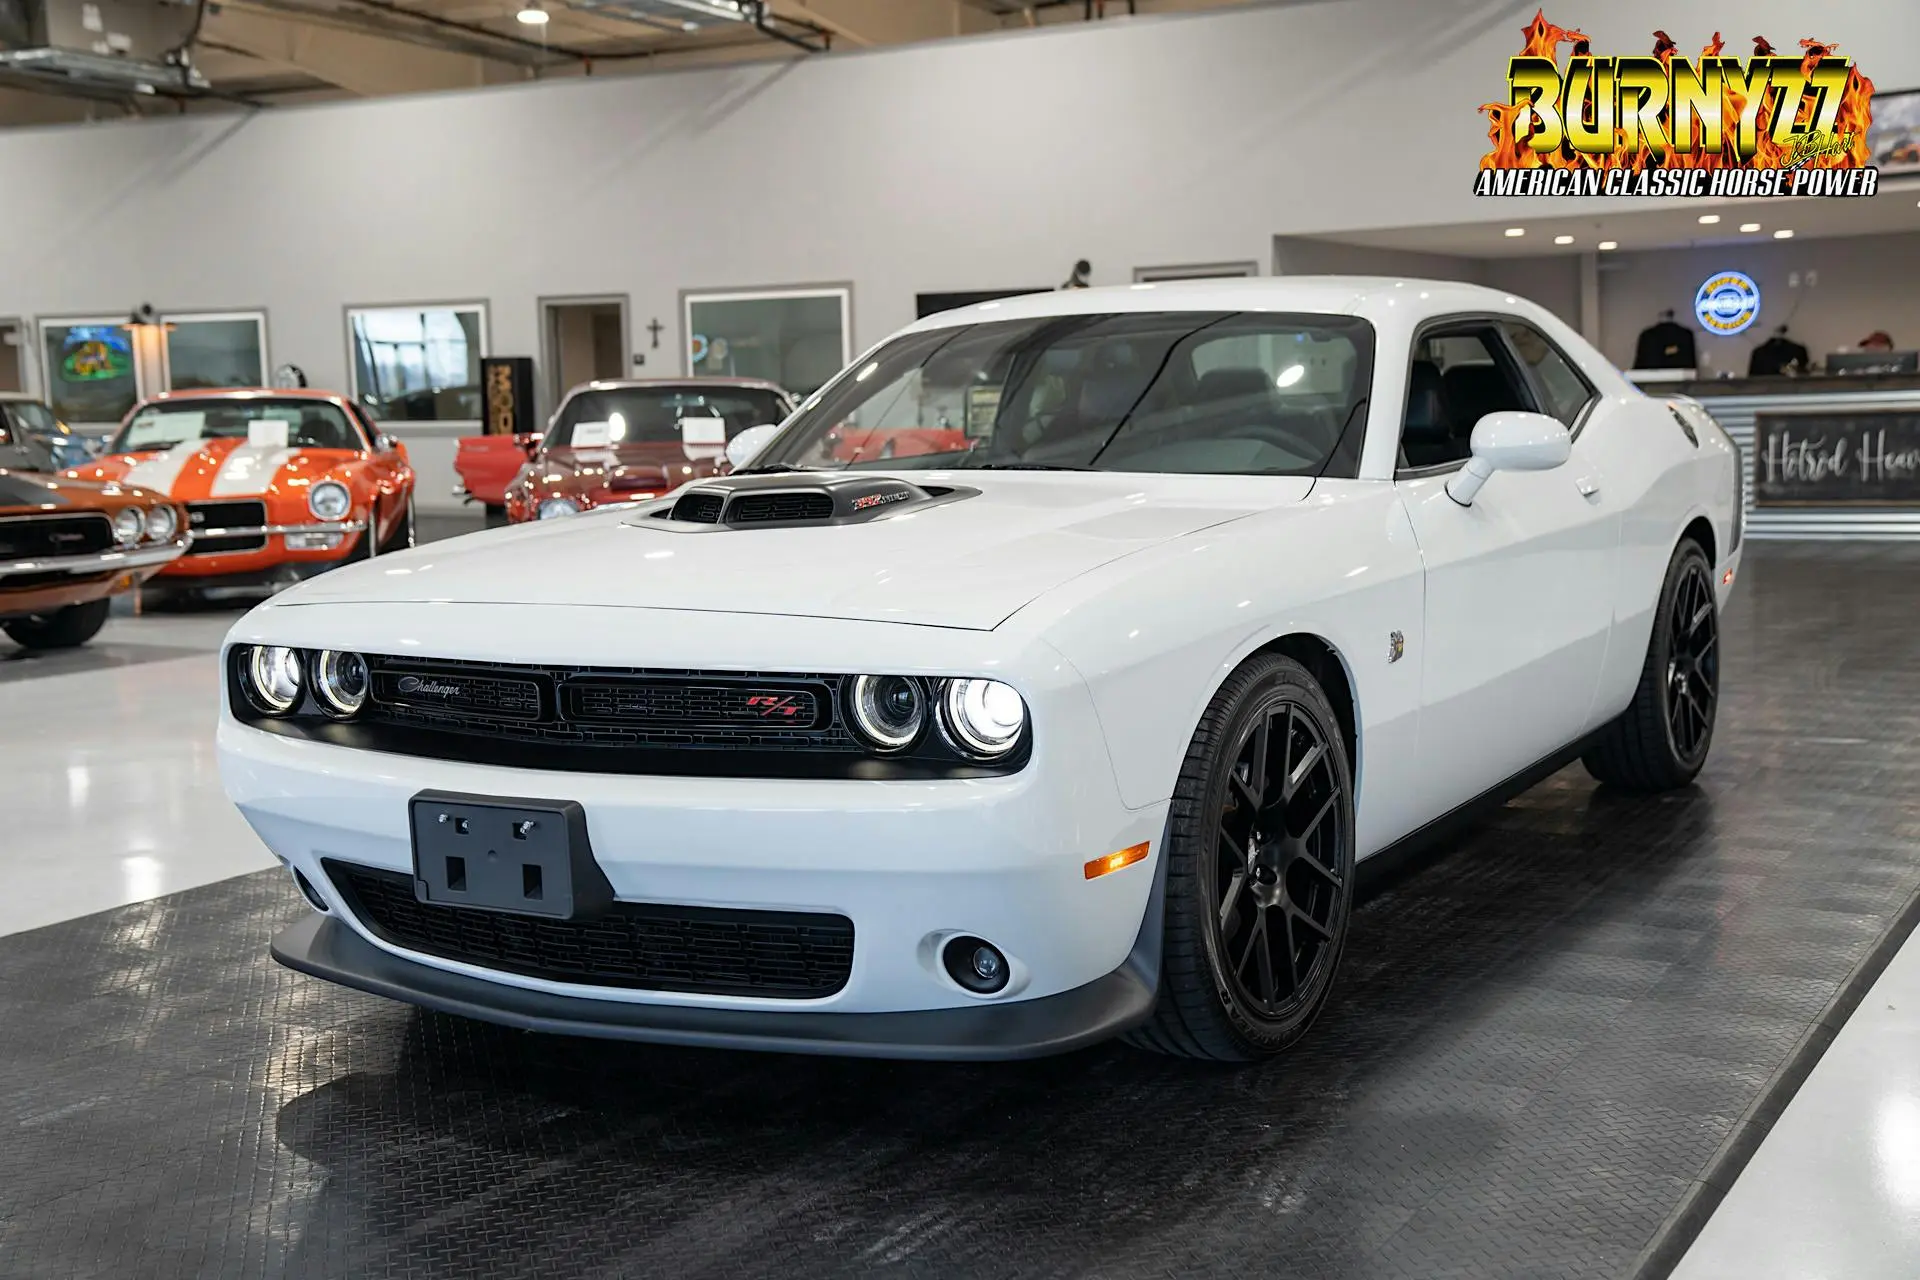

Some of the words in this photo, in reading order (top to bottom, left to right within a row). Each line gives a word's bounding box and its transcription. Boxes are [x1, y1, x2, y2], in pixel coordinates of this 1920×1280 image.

[1761, 430, 1848, 482] Hotrod
[1855, 428, 1920, 482] Heav
[398, 676, 461, 699] Challenger
[746, 695, 806, 716] R/T
